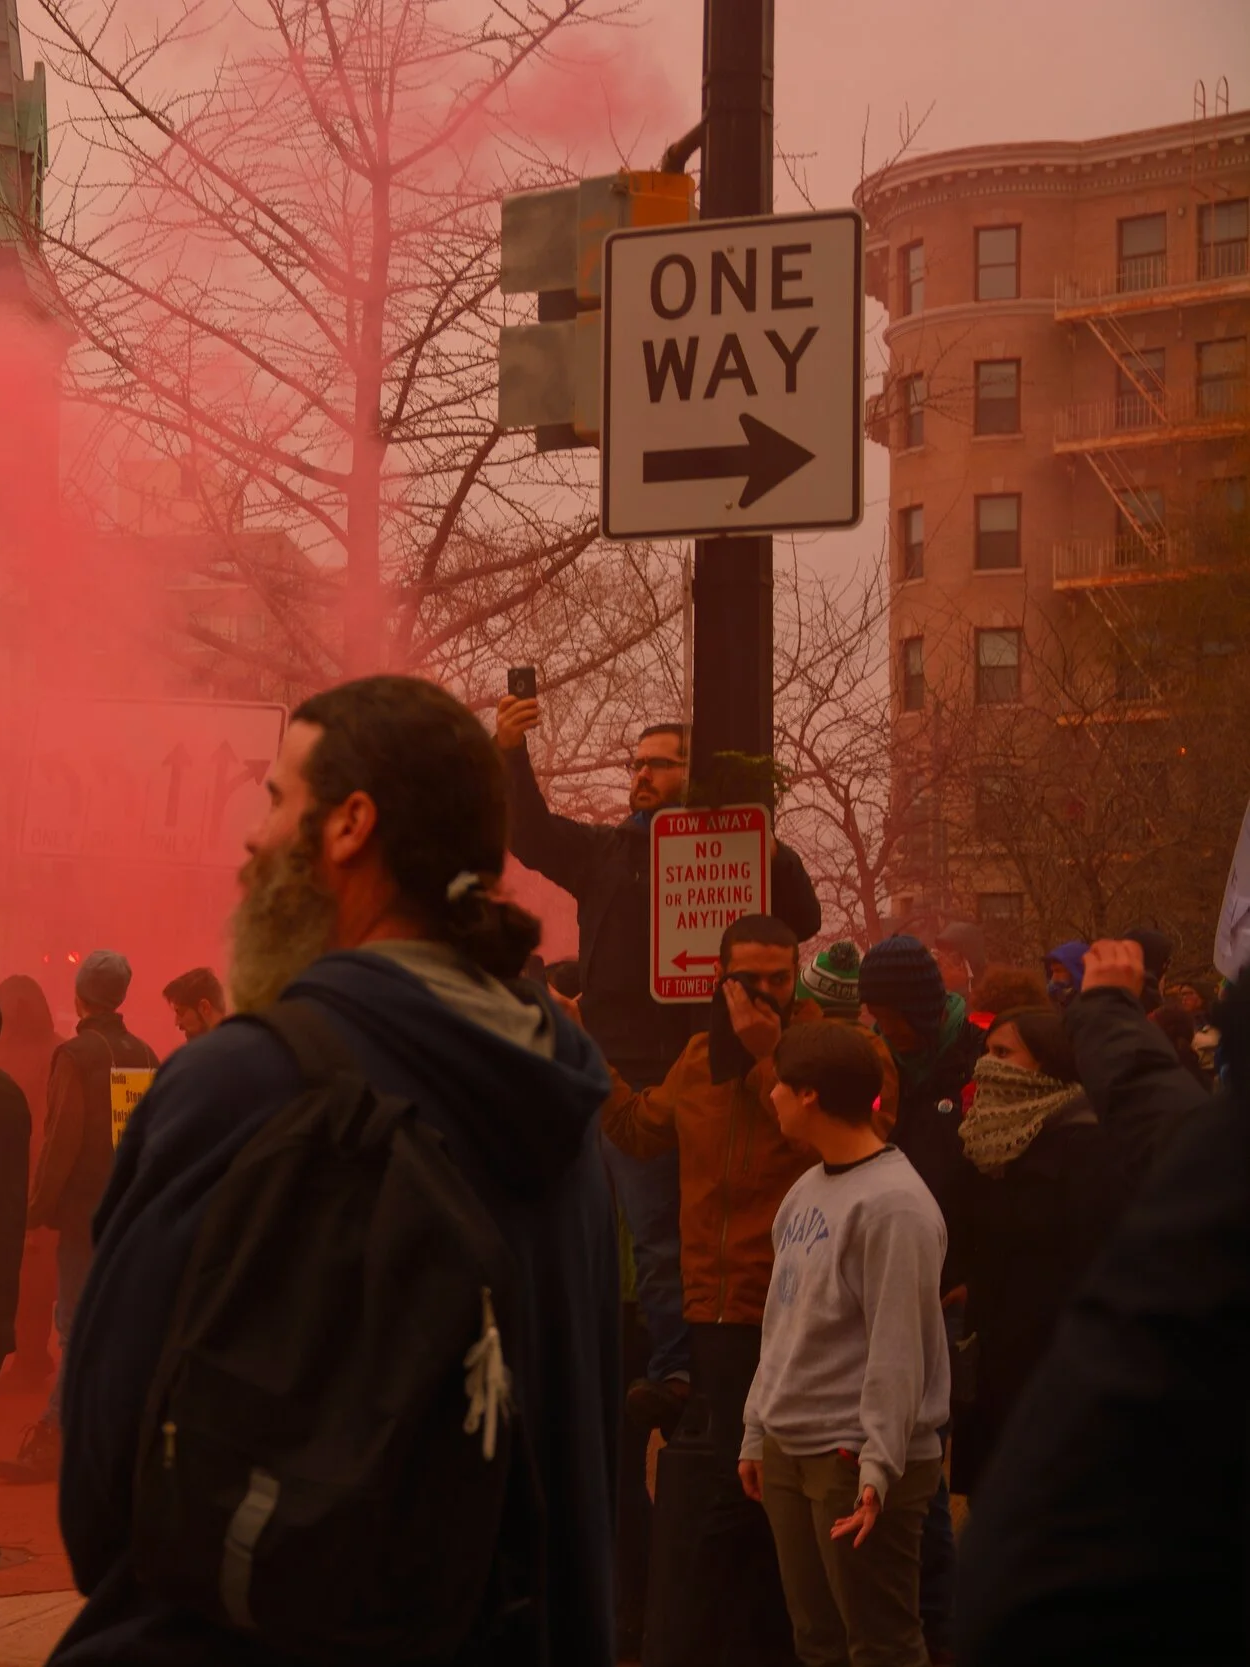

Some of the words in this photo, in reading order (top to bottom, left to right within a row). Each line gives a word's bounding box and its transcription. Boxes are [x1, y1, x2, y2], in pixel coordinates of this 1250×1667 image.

[650, 243, 814, 320] ONE
[642, 326, 820, 403] WAY
[668, 816, 699, 833] TOW
[707, 813, 752, 831] AWAY
[695, 841, 722, 859] NO
[666, 862, 750, 883] STANDING
[687, 886, 753, 906] PARKING
[661, 980, 670, 995] IF
[675, 979, 707, 995] TOWED
[780, 1207, 829, 1255] NAVY
